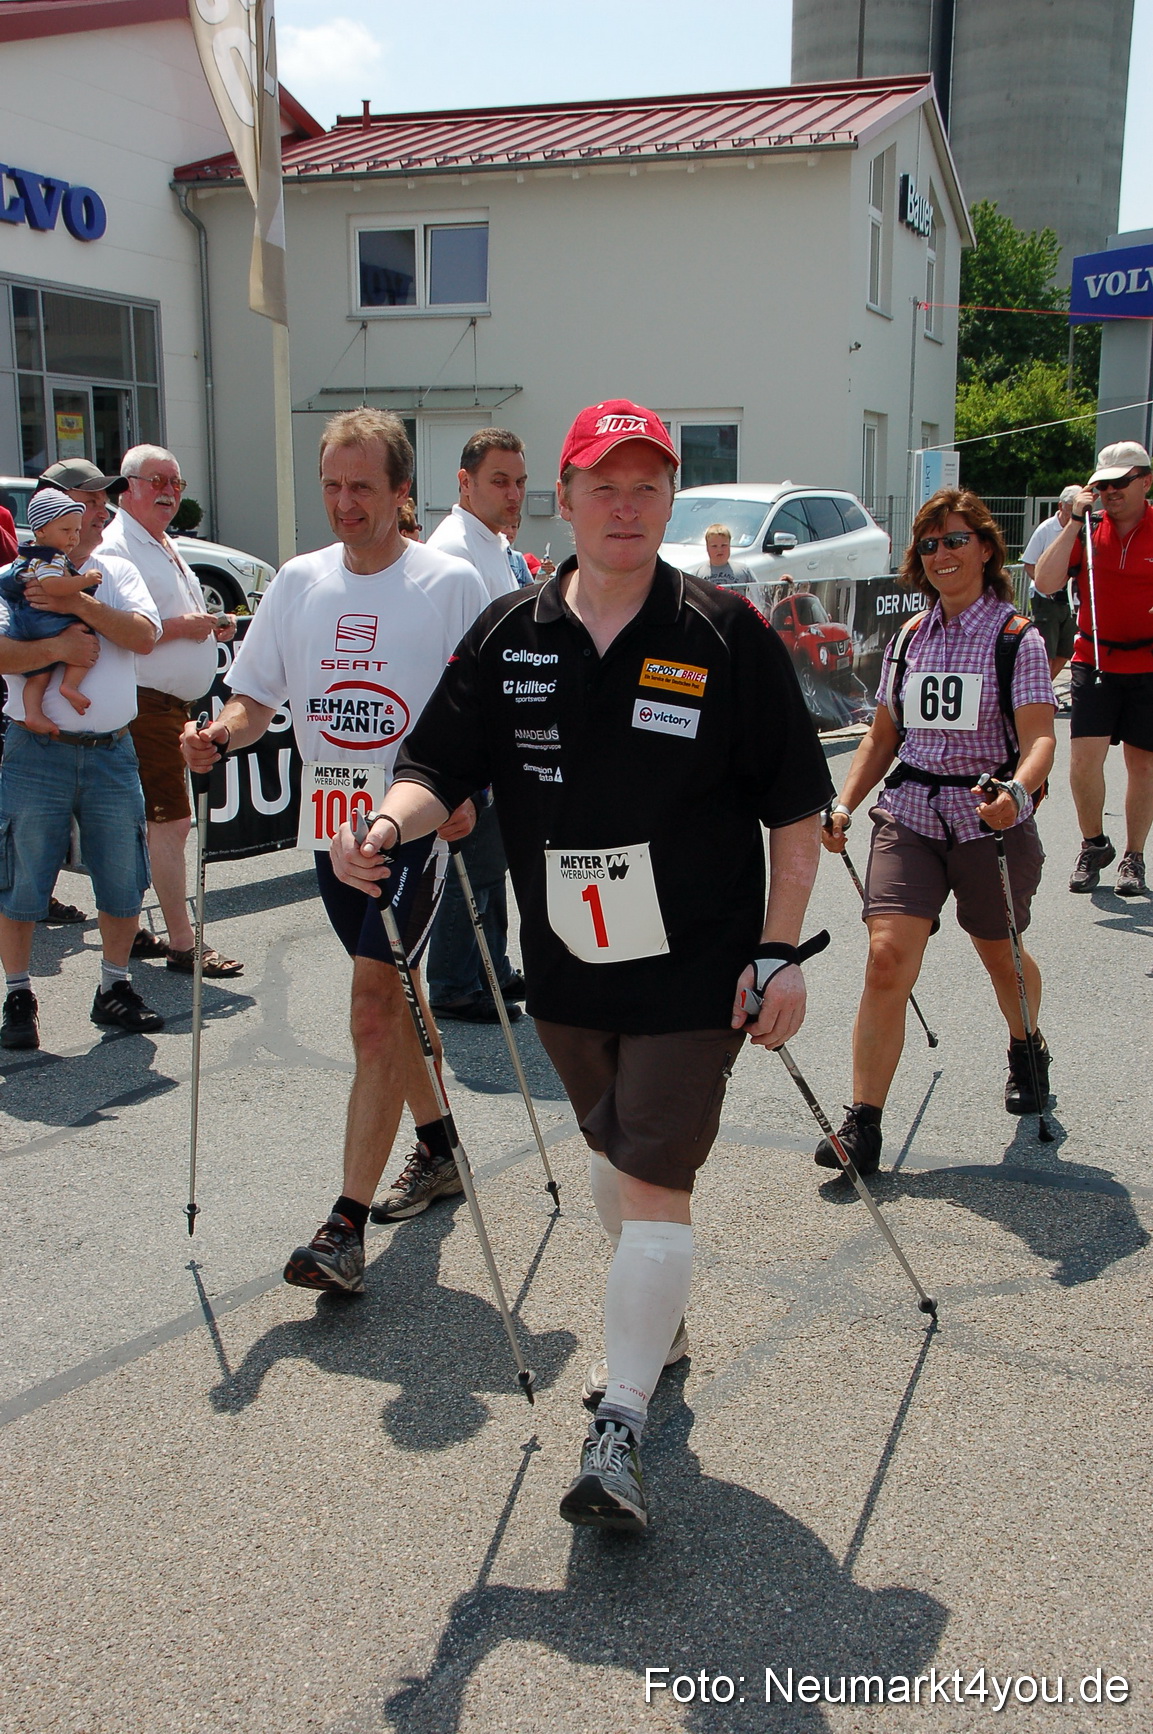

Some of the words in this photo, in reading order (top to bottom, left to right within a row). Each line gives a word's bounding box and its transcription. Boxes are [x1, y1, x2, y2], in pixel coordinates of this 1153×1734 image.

[907, 175, 933, 237] Bauer
[876, 594, 900, 616] DER
[502, 648, 559, 667] Cellagon
[320, 659, 389, 672] SEAT
[680, 669, 707, 683] BRIEF
[515, 680, 557, 694] killtec
[920, 675, 964, 722] 69
[384, 704, 395, 715] &
[653, 711, 692, 729] victory
[514, 729, 560, 741] AMADEUS
[315, 766, 350, 778] MEYER
[314, 778, 351, 787] WERBUNG
[560, 855, 603, 869] MEYER
[560, 869, 606, 880] WERBUNG
[581, 884, 610, 948] 1
